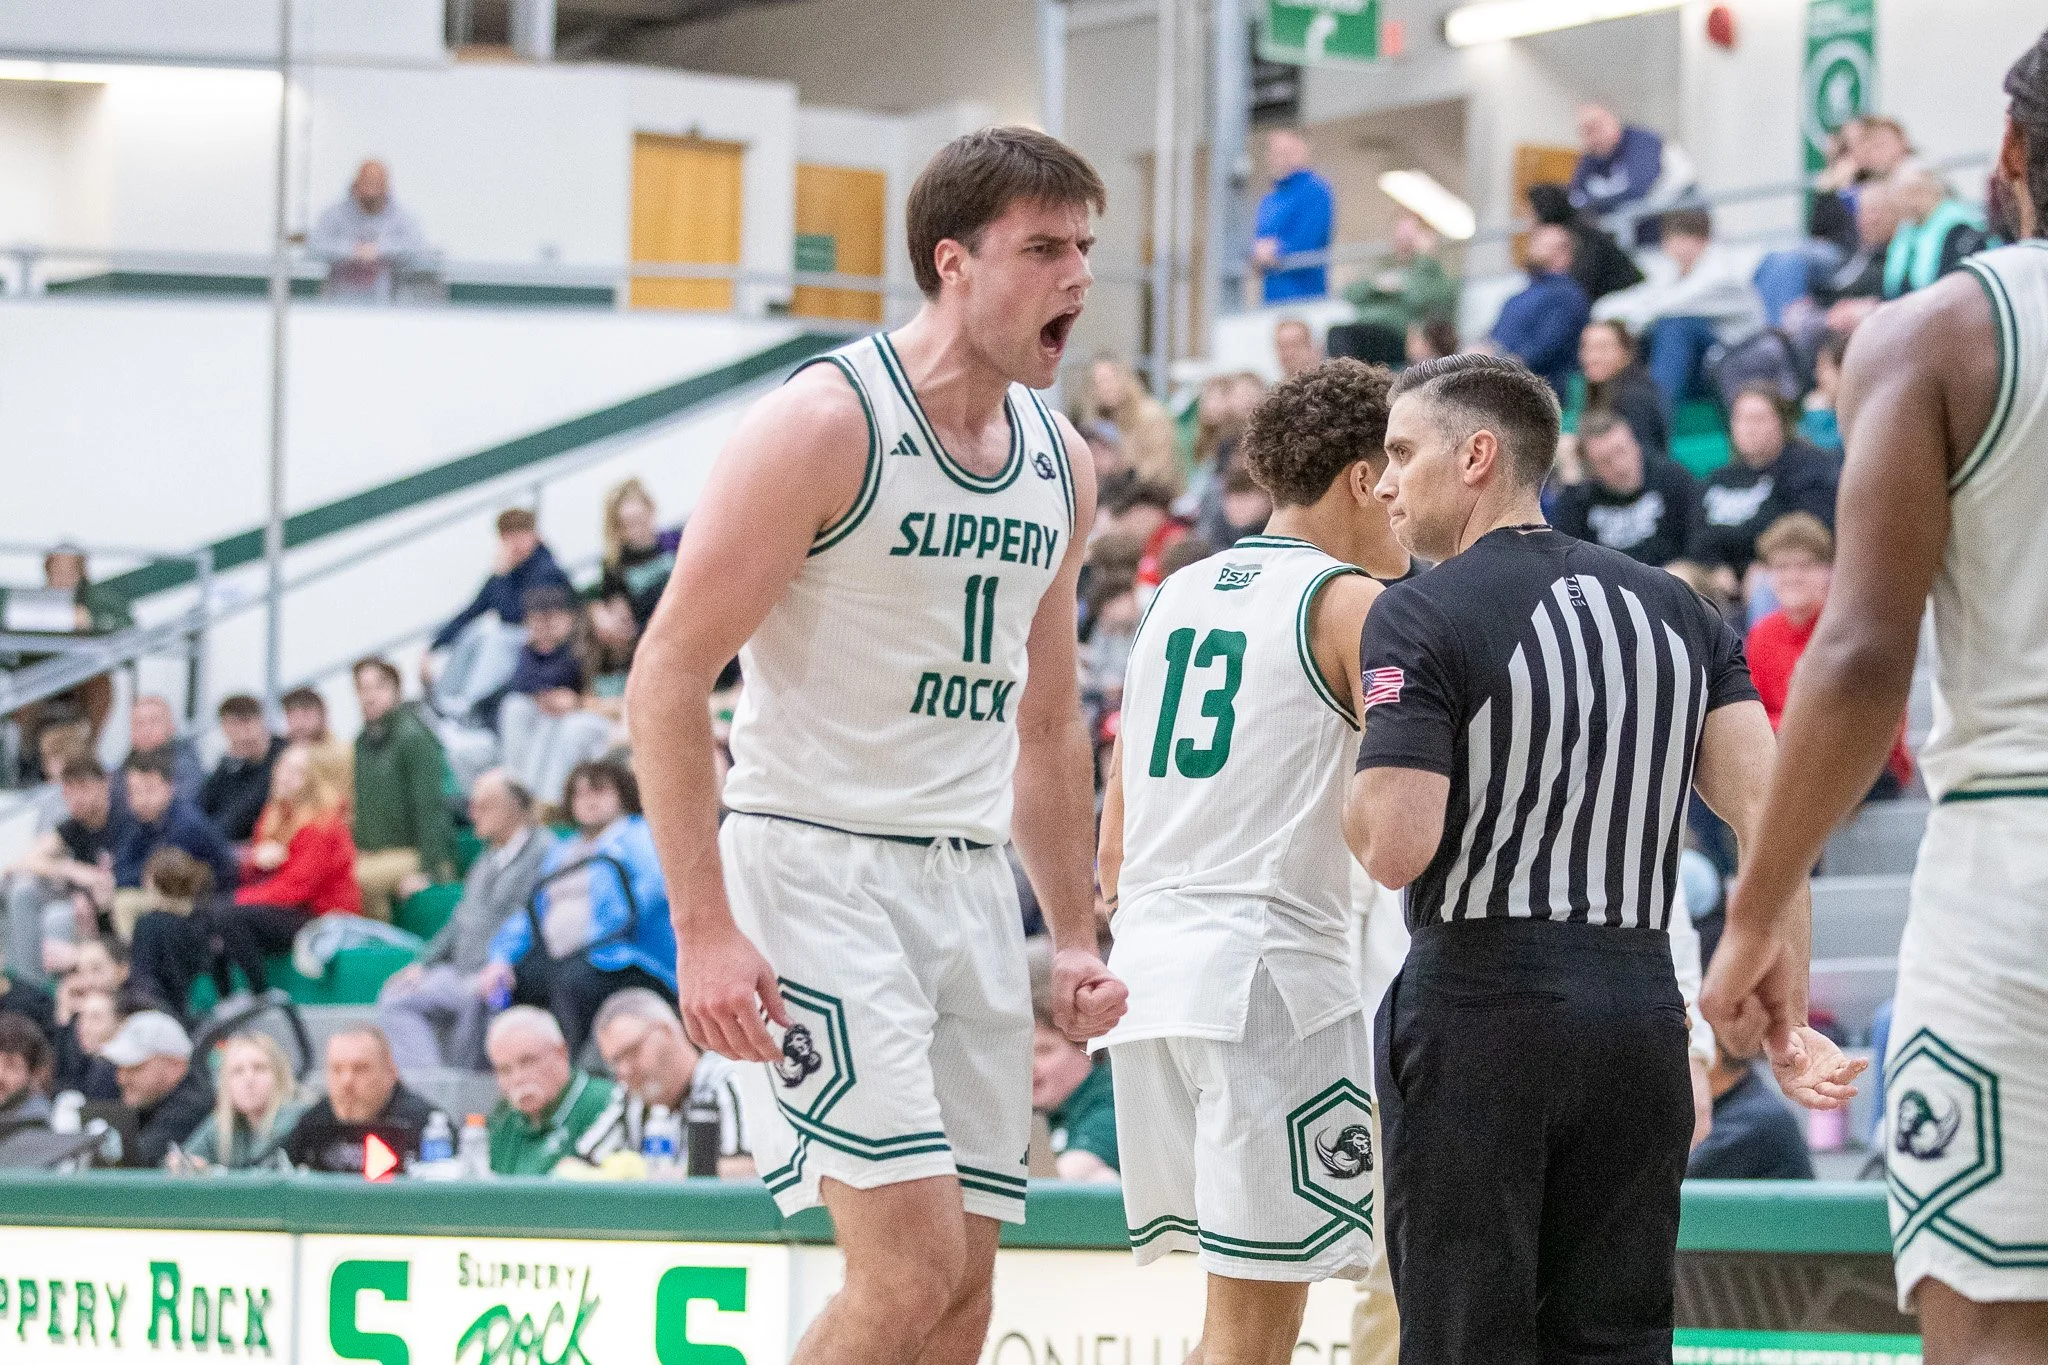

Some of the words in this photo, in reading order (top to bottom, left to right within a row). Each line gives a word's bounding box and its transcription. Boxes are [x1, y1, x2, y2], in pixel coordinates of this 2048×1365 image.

[889, 511, 1059, 570] SLIPPERY
[962, 574, 999, 665] 11
[909, 671, 1017, 723] ROCK
[1148, 627, 1247, 778] 13
[147, 1260, 272, 1352] ROCK
